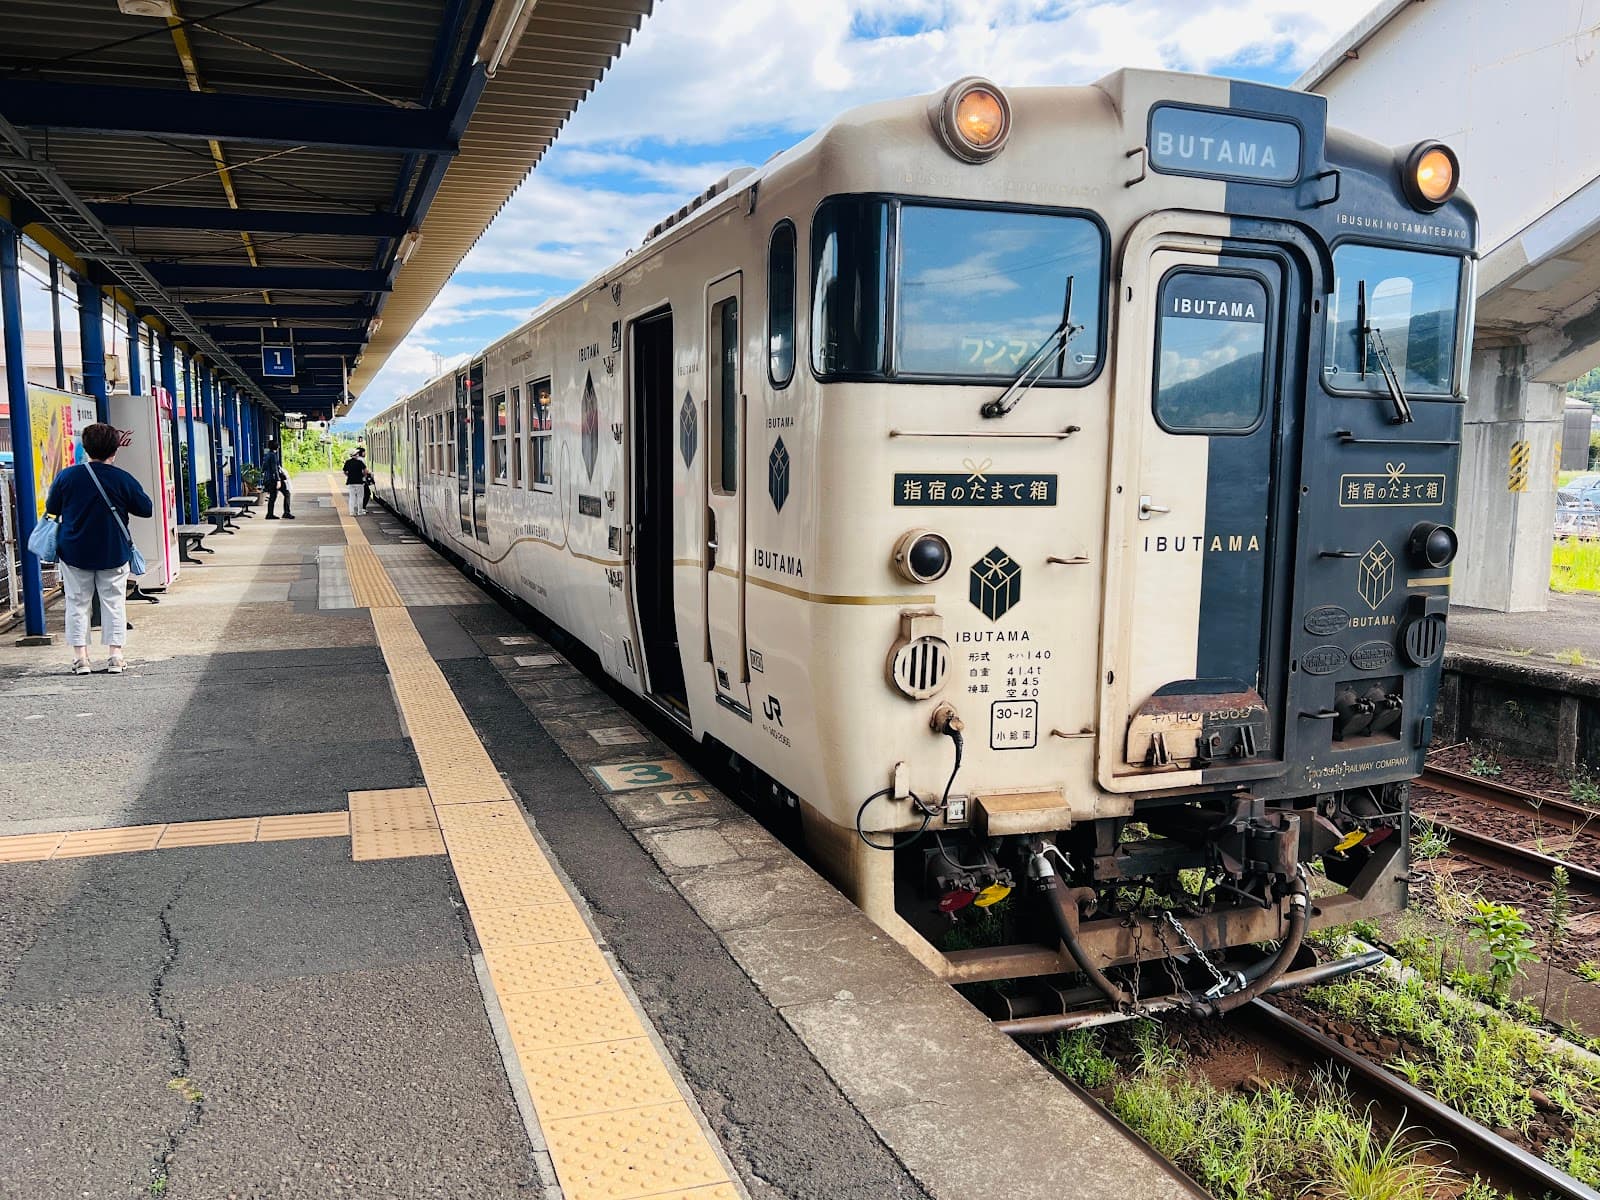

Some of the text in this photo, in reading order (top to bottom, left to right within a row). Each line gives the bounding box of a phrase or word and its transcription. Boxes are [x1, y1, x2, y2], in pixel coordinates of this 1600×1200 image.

[1336, 213, 1467, 239] IBUSUKI NO TAMATEBAKO
[1174, 298, 1255, 318] IBUTAMA
[273, 351, 281, 365] 1
[766, 416, 794, 429] IBUTAMA
[903, 480, 1049, 501] 指宿のたまて箱
[1347, 481, 1439, 500] 指宿のたまて箱
[1144, 535, 1260, 552] IBUTAMA
[754, 548, 803, 578] IBUTAMA
[1348, 615, 1396, 628] IBUTAMA
[956, 631, 1030, 642] IBUTAMA
[968, 652, 990, 662] 形式
[763, 694, 784, 728] JR
[996, 707, 1033, 719] 30-12
[1344, 762, 1374, 774] RAILWAY
[1375, 756, 1409, 769] COMPANY
[617, 764, 674, 785] 3
[672, 791, 699, 802] 4
